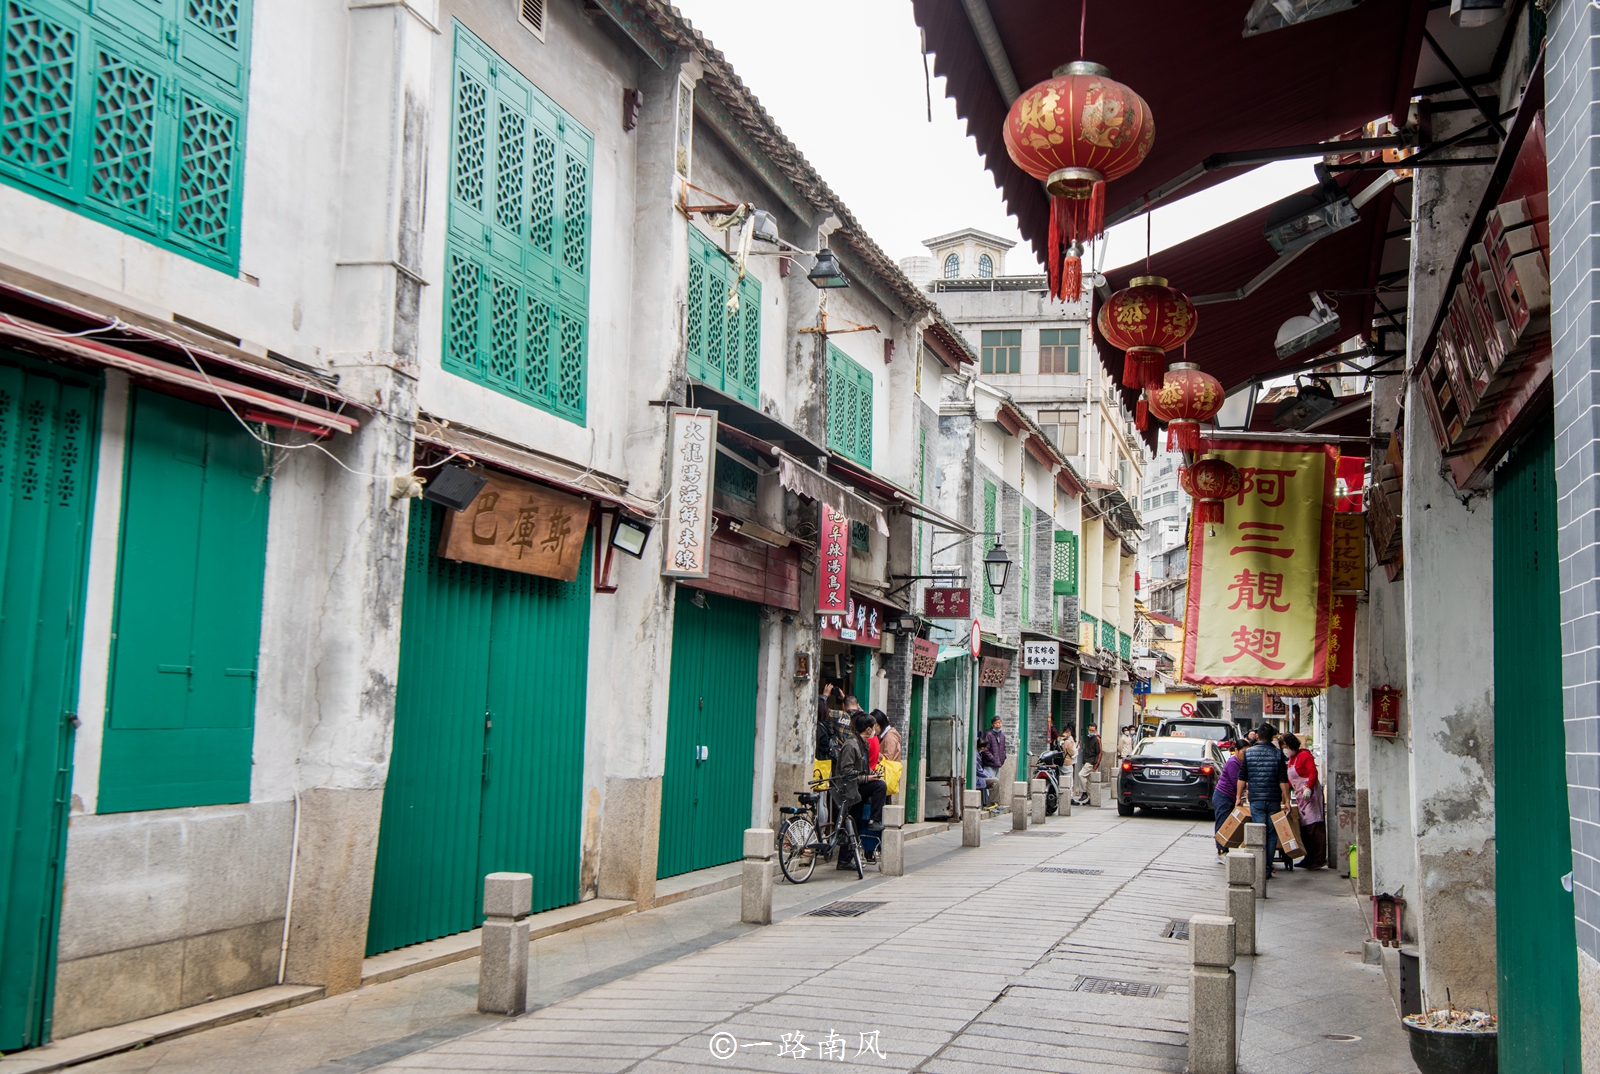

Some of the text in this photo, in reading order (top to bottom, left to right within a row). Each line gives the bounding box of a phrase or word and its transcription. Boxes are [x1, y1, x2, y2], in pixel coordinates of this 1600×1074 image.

[471, 490, 572, 566] 巴庫斯
[674, 421, 705, 571] 火龍湯海鮮米線
[1222, 466, 1297, 671] 阿三靚翅
[1026, 646, 1056, 655] 百家綜合
